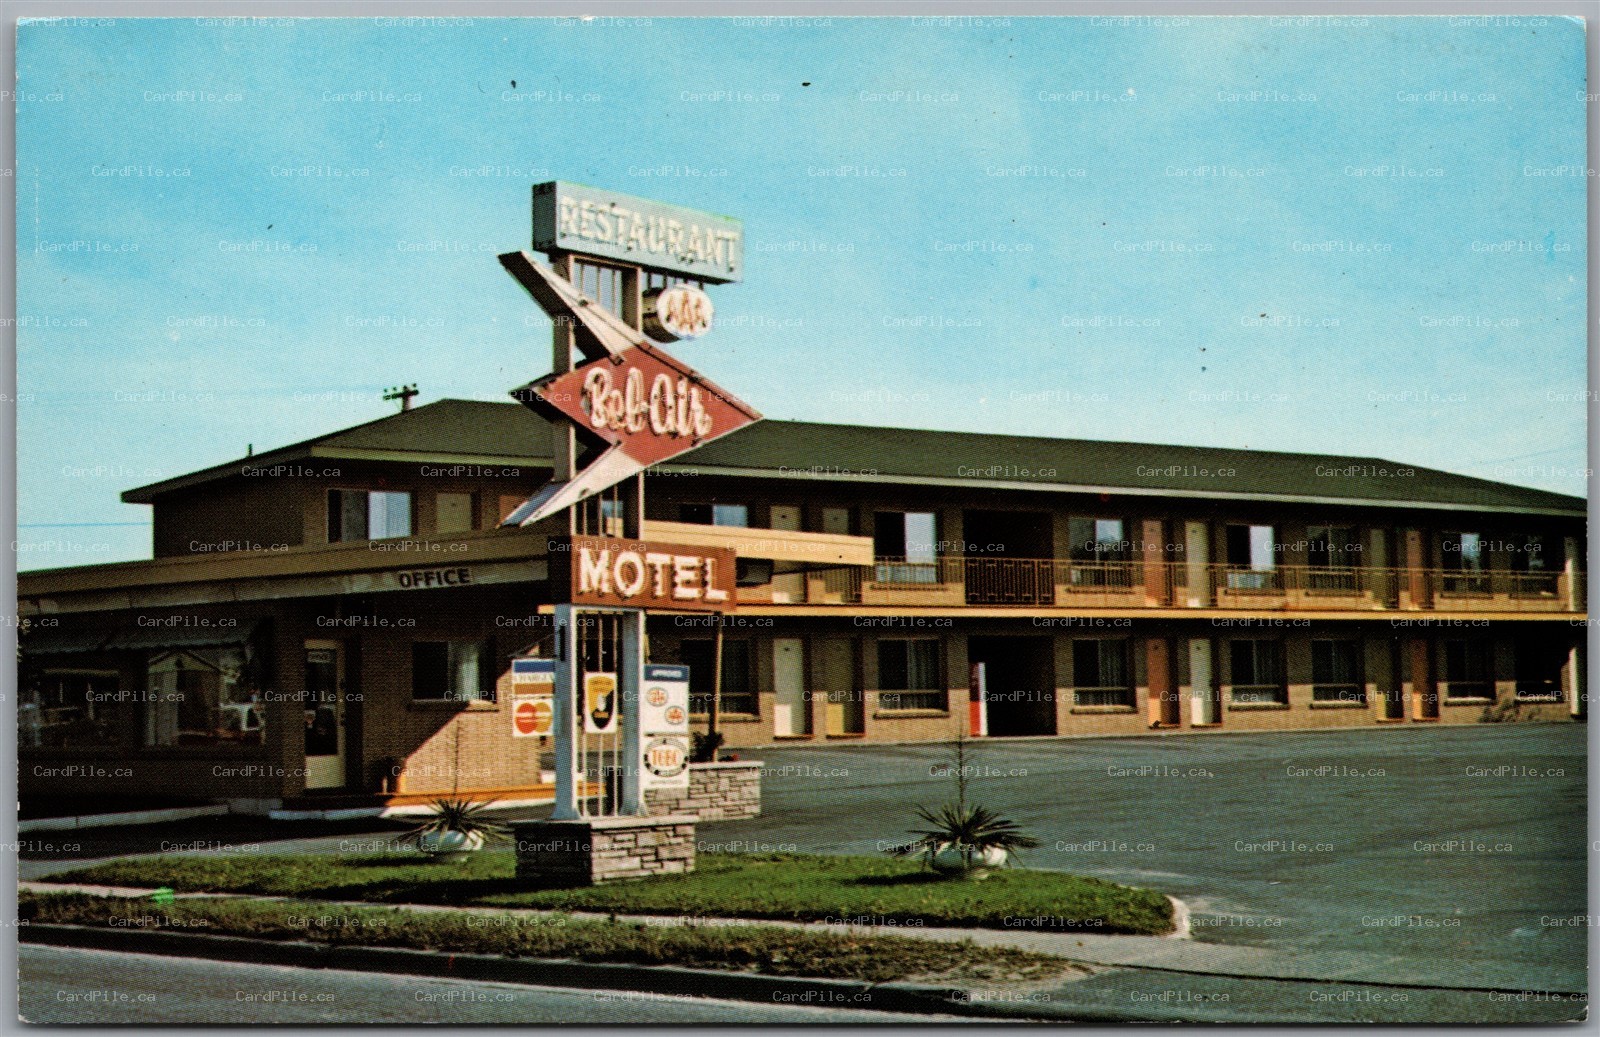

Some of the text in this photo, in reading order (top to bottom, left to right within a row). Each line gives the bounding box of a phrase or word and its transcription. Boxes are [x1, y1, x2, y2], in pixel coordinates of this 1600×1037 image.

[560, 195, 739, 268] RESTAURANT
[666, 290, 707, 332] AAA
[584, 366, 713, 437] Bel-Air
[399, 568, 471, 588] OFFICE
[579, 547, 730, 601] MOTEL
